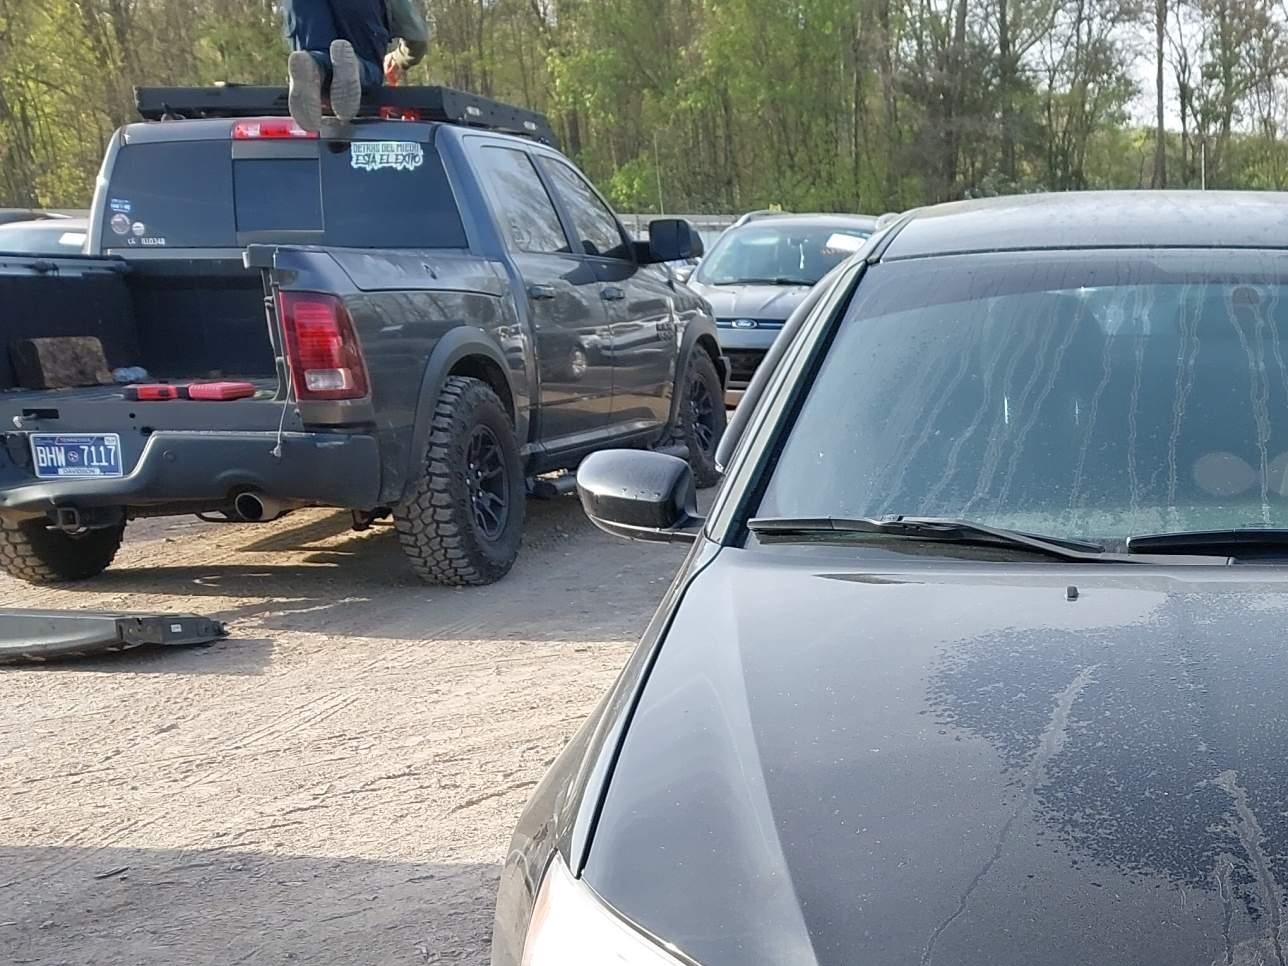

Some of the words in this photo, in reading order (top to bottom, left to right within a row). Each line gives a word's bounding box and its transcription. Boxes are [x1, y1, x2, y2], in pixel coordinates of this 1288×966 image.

[381, 143, 395, 153] DEL
[379, 154, 393, 165] EL
[36, 446, 66, 467] BHW
[79, 445, 116, 466] 7117
